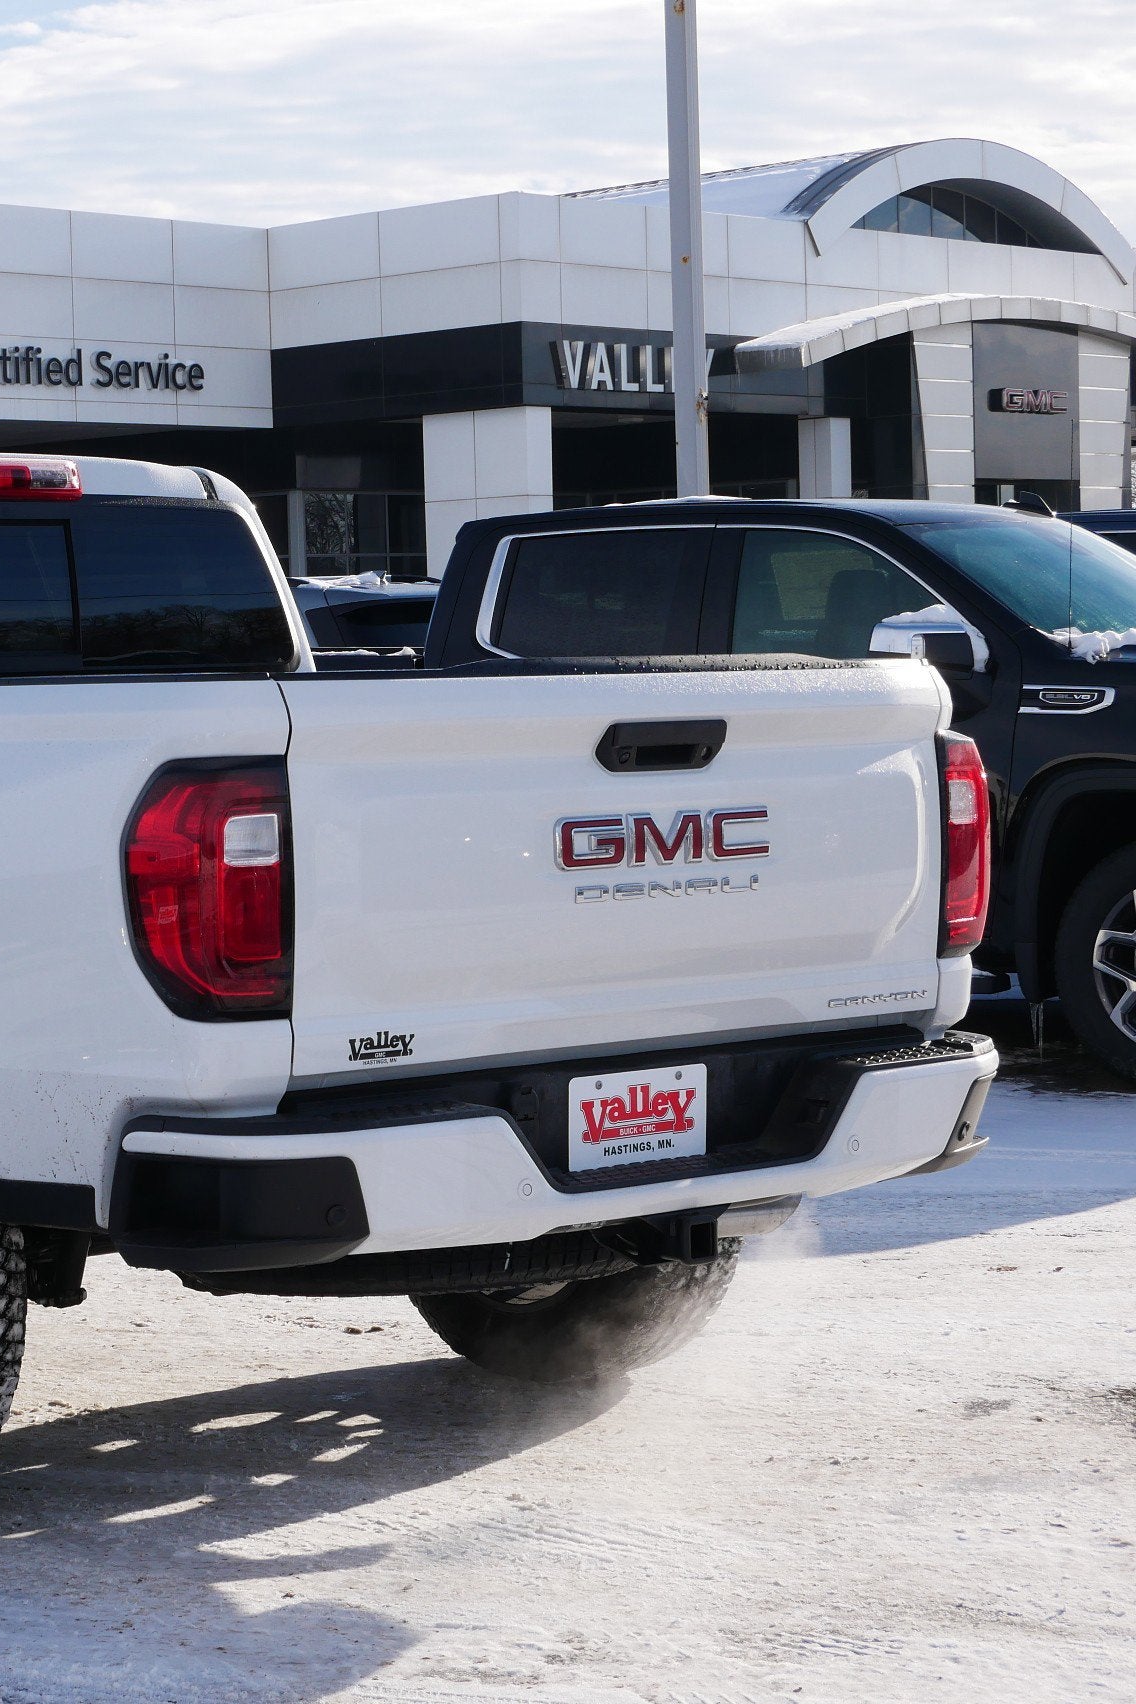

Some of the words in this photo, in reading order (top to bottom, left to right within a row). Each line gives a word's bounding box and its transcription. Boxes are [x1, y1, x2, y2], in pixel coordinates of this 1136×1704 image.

[92, 350, 205, 391] Service
[560, 339, 715, 394] VALL
[1002, 388, 1068, 413] GMC
[553, 806, 770, 871] GMC
[575, 874, 759, 904] DENALI
[827, 989, 928, 1008] CANYON
[348, 1031, 415, 1061] Valley
[580, 1083, 697, 1145] Valley
[619, 1127, 638, 1136] BUICK
[642, 1124, 656, 1133] GMC
[603, 1141, 655, 1157] HASTINGS,
[657, 1138, 675, 1150] MN.
